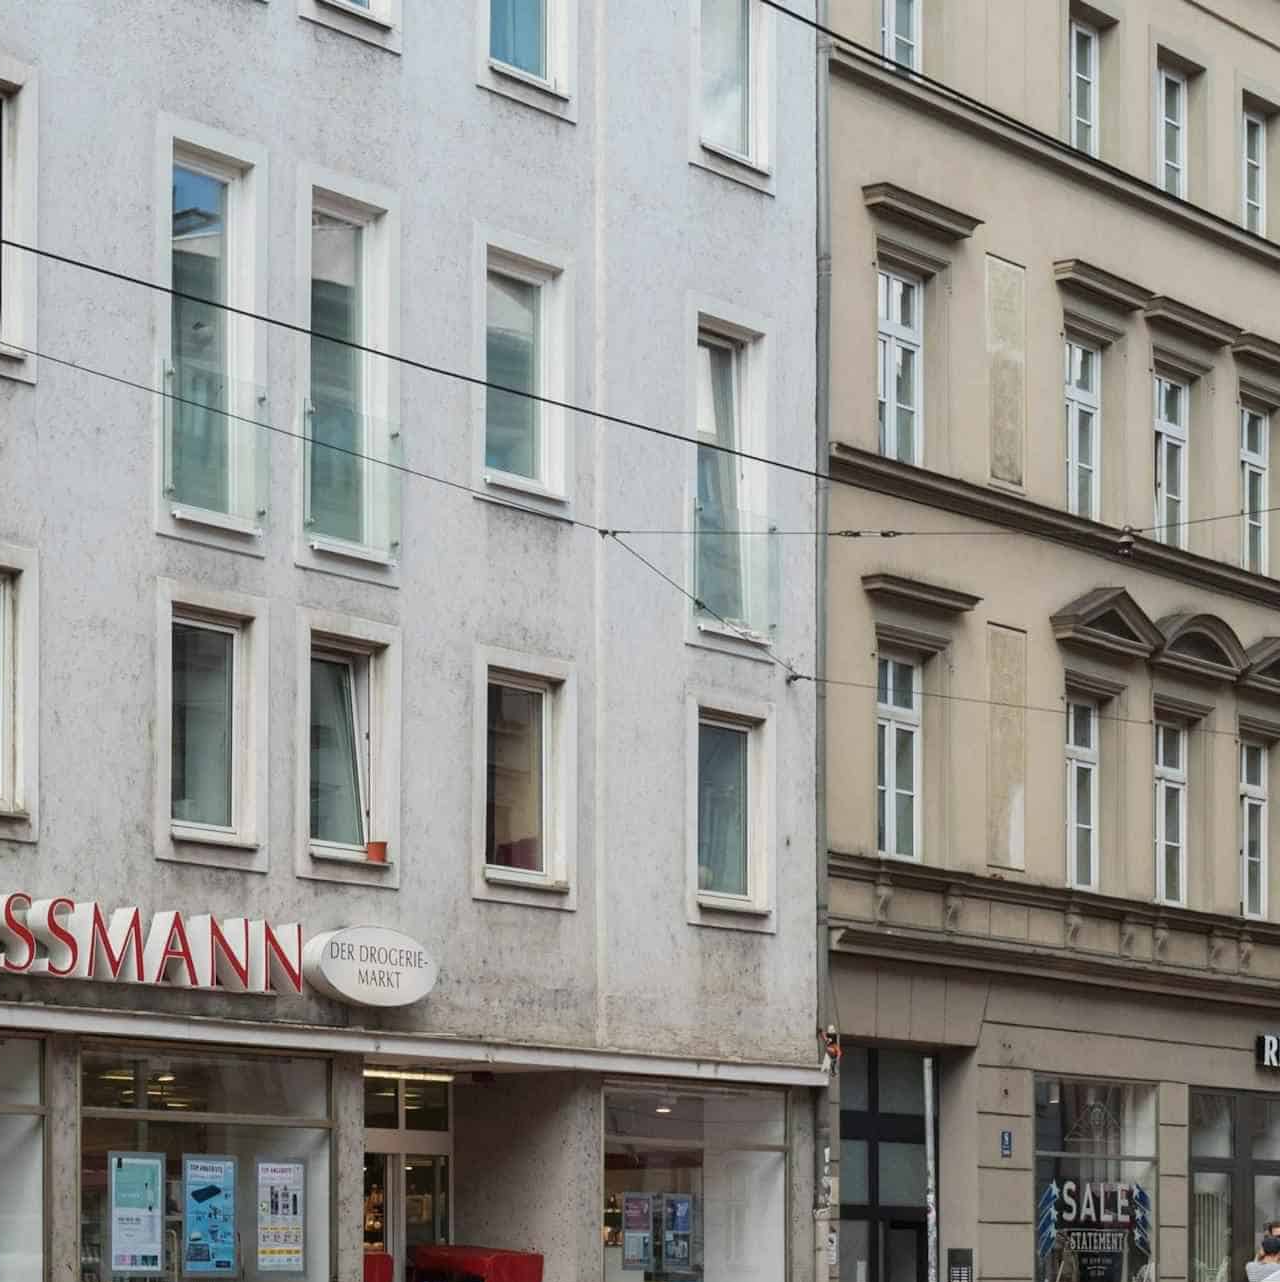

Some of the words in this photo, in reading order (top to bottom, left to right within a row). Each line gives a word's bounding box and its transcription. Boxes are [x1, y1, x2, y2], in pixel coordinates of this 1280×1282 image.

[329, 941, 355, 962] DER
[358, 945, 430, 968] DROGERIE-
[358, 969, 402, 991] MARKT
[1264, 1035, 1280, 1067] R
[1062, 1181, 1130, 1222] SALE
[1070, 1233, 1123, 1250] STATEMENT
